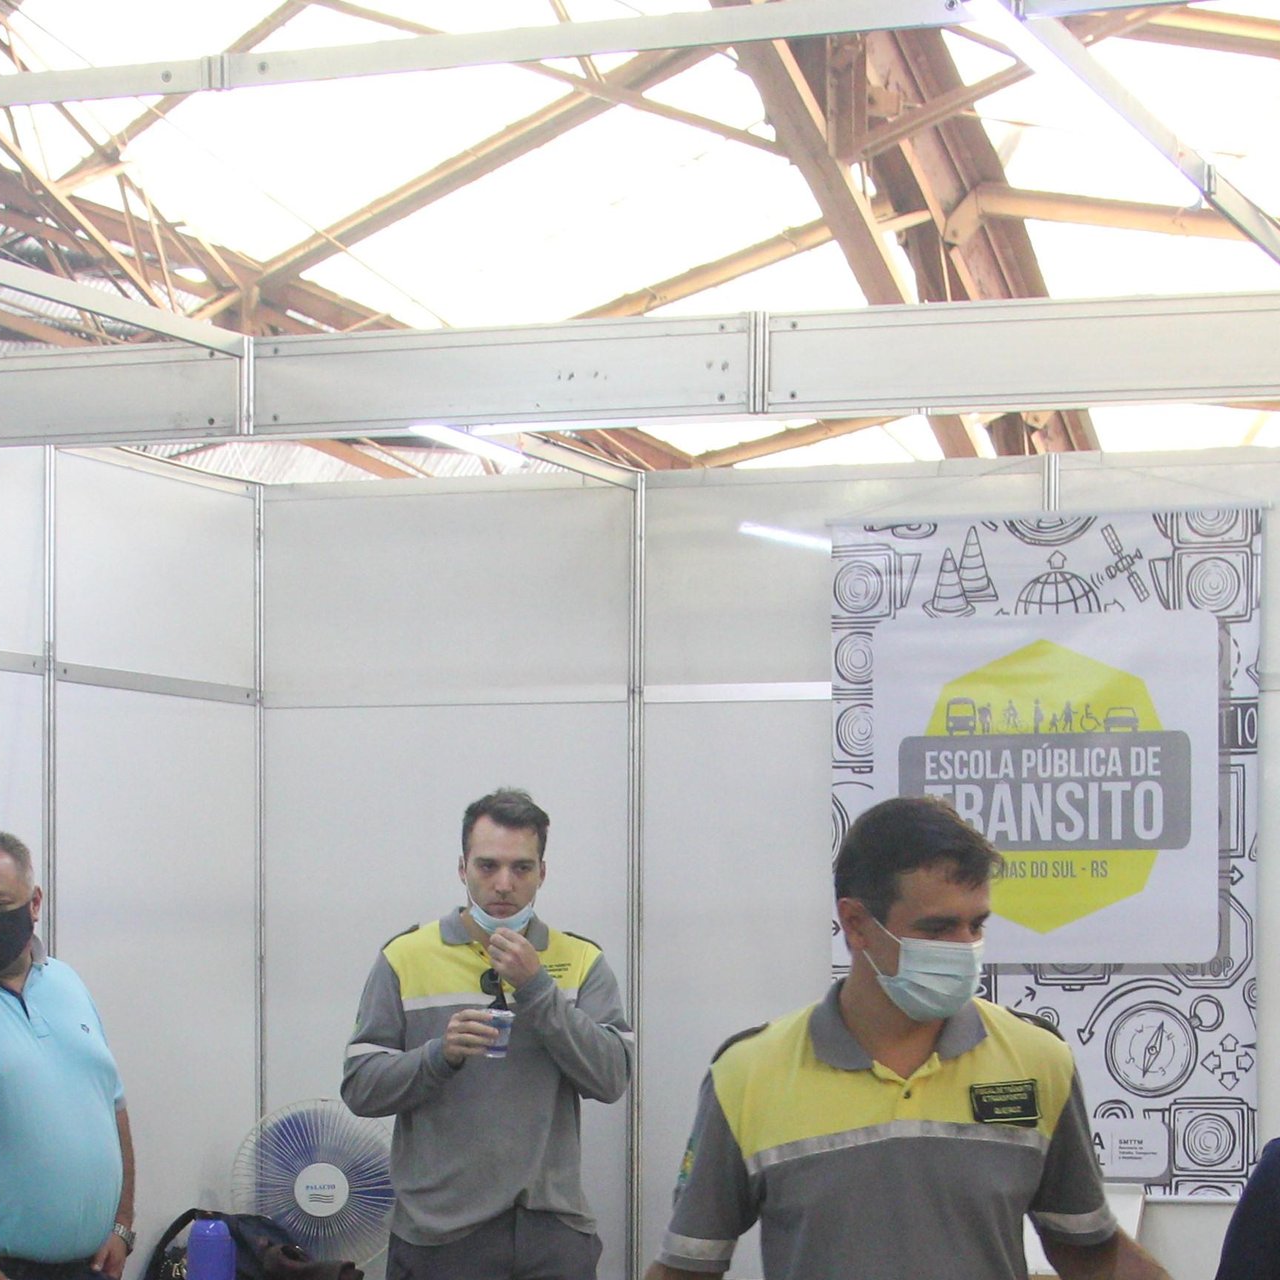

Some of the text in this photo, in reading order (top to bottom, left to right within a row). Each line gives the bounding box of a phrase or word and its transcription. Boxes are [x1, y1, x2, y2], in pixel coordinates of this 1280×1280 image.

[924, 742, 1161, 780] ESCOLA PÚBLICA DE
[1031, 860, 1048, 878] DO
[1052, 860, 1077, 878] SUL
[1091, 859, 1108, 878] RS
